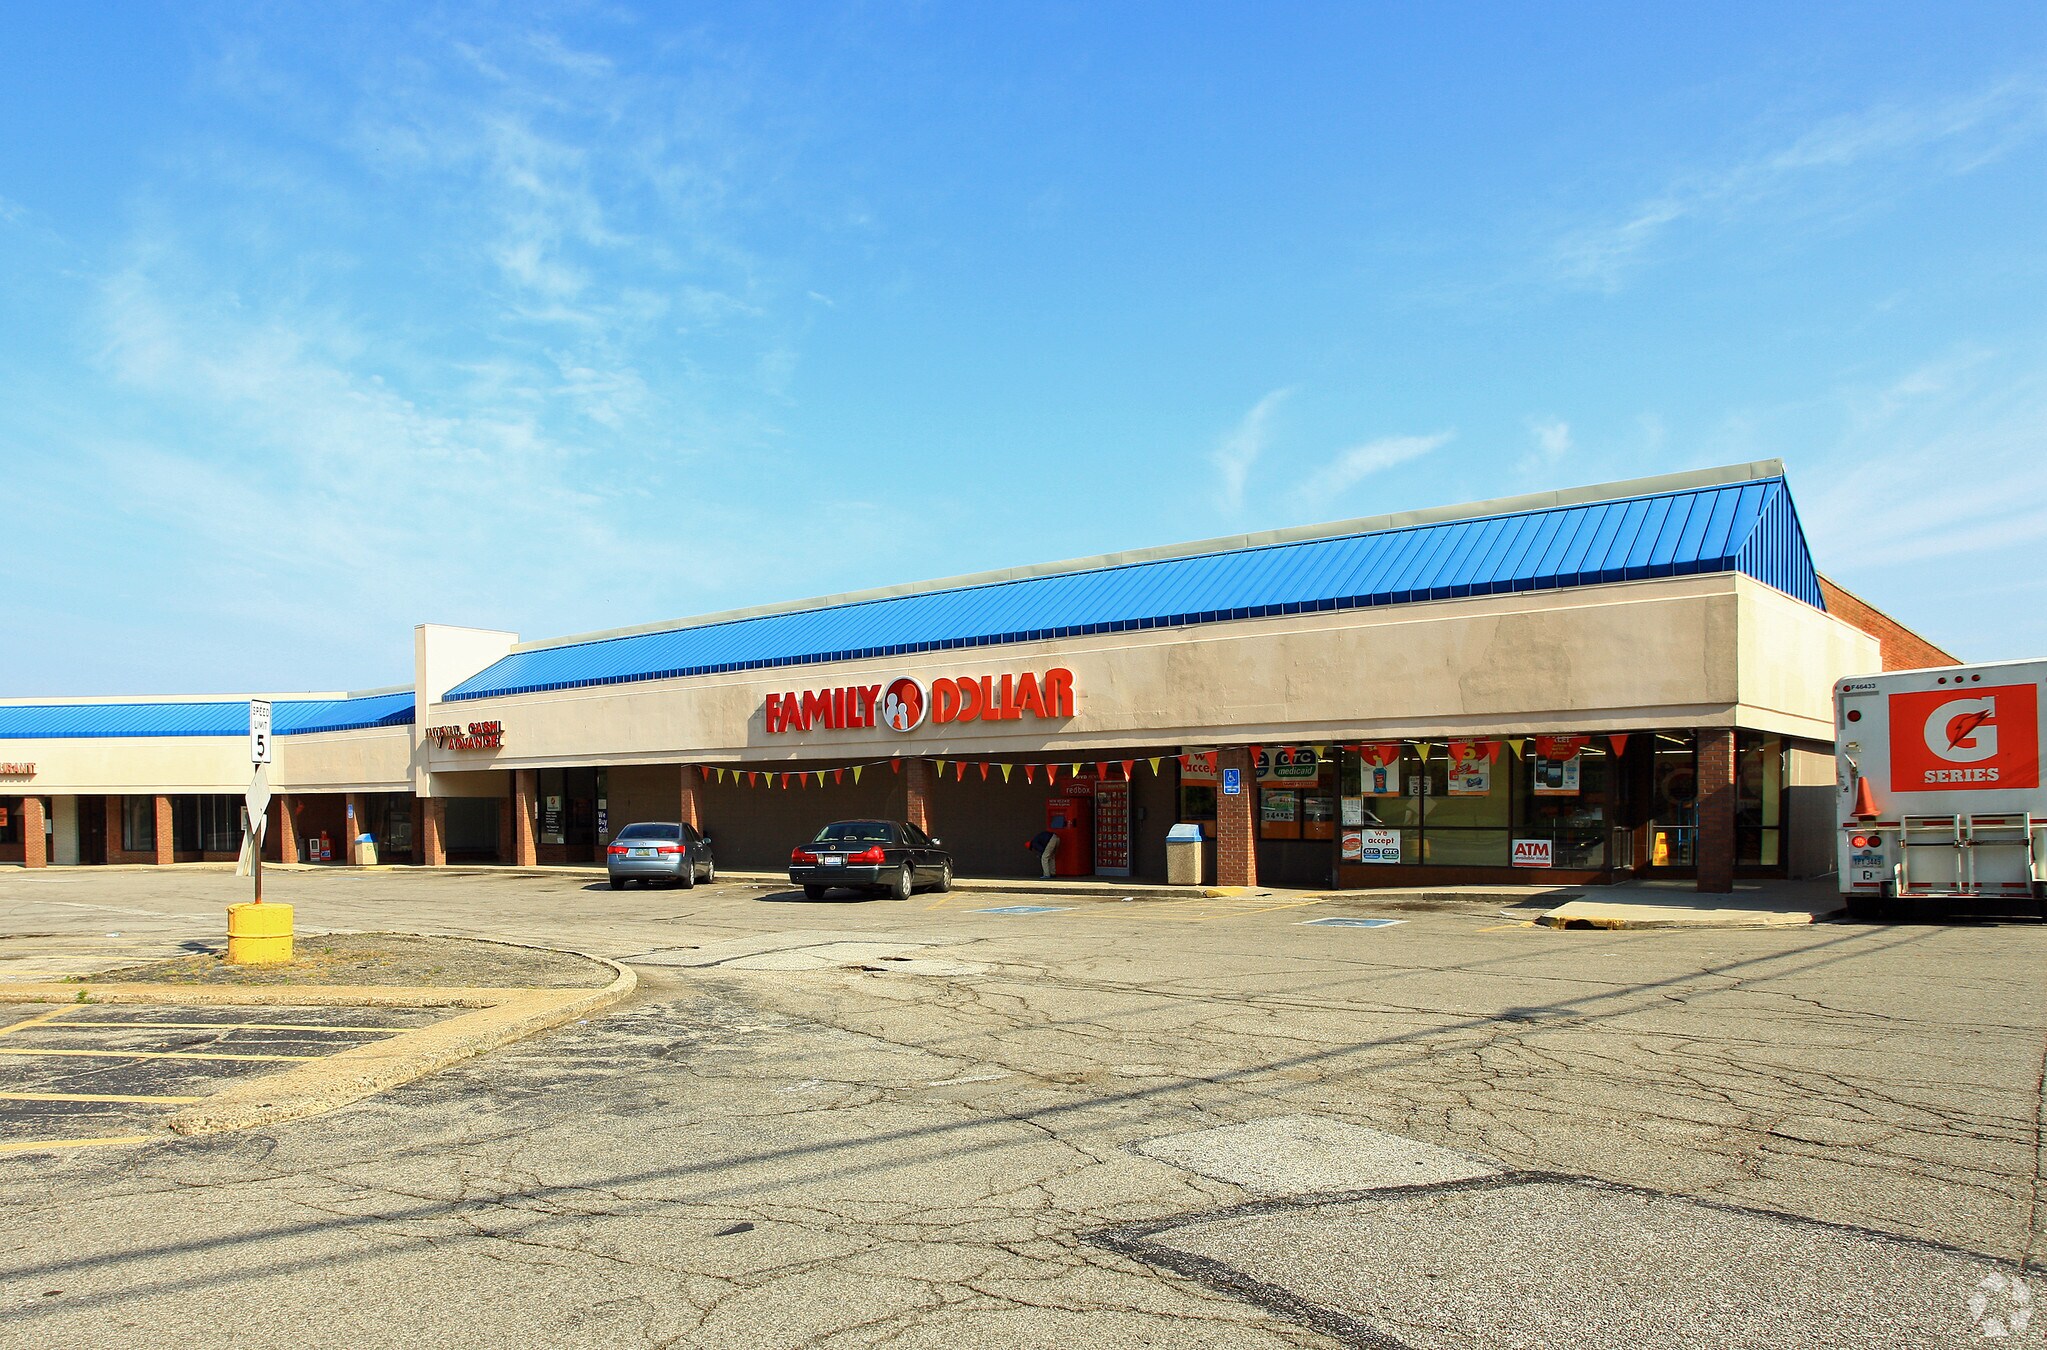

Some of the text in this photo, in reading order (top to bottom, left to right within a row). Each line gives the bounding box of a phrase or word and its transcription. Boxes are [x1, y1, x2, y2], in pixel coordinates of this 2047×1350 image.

[765, 667, 1078, 733] FAMILY DOLLAR
[253, 706, 270, 717] SPEED
[1923, 695, 1998, 763] G
[257, 735, 265, 757] 5
[1278, 766, 1313, 775] medicaid
[1924, 767, 2000, 784] SERIES
[1367, 837, 1395, 845] accept
[1514, 843, 1549, 856] ATM
